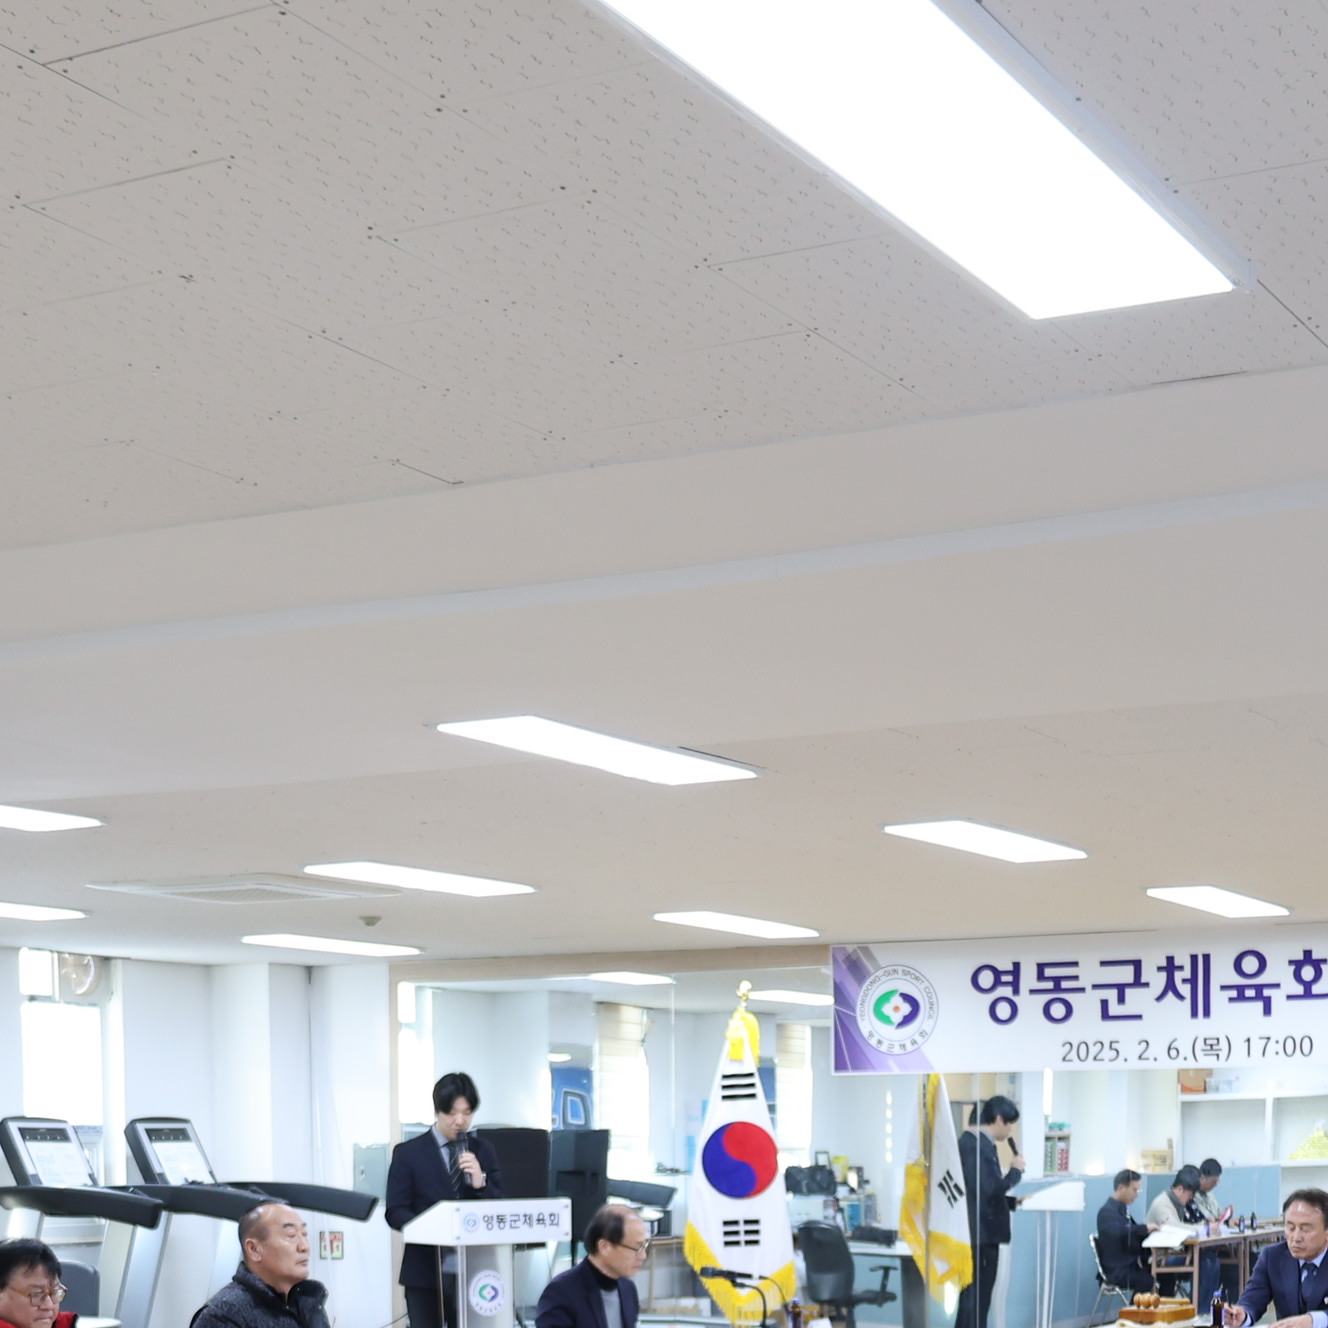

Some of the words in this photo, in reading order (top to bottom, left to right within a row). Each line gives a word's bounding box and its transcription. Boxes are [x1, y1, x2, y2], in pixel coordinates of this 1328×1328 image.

[1060, 1039, 1129, 1063] 2025.
[1136, 1038, 1159, 1062] 2.
[1243, 1034, 1314, 1059] 17:00
[482, 1212, 560, 1231] 영동군체육회
